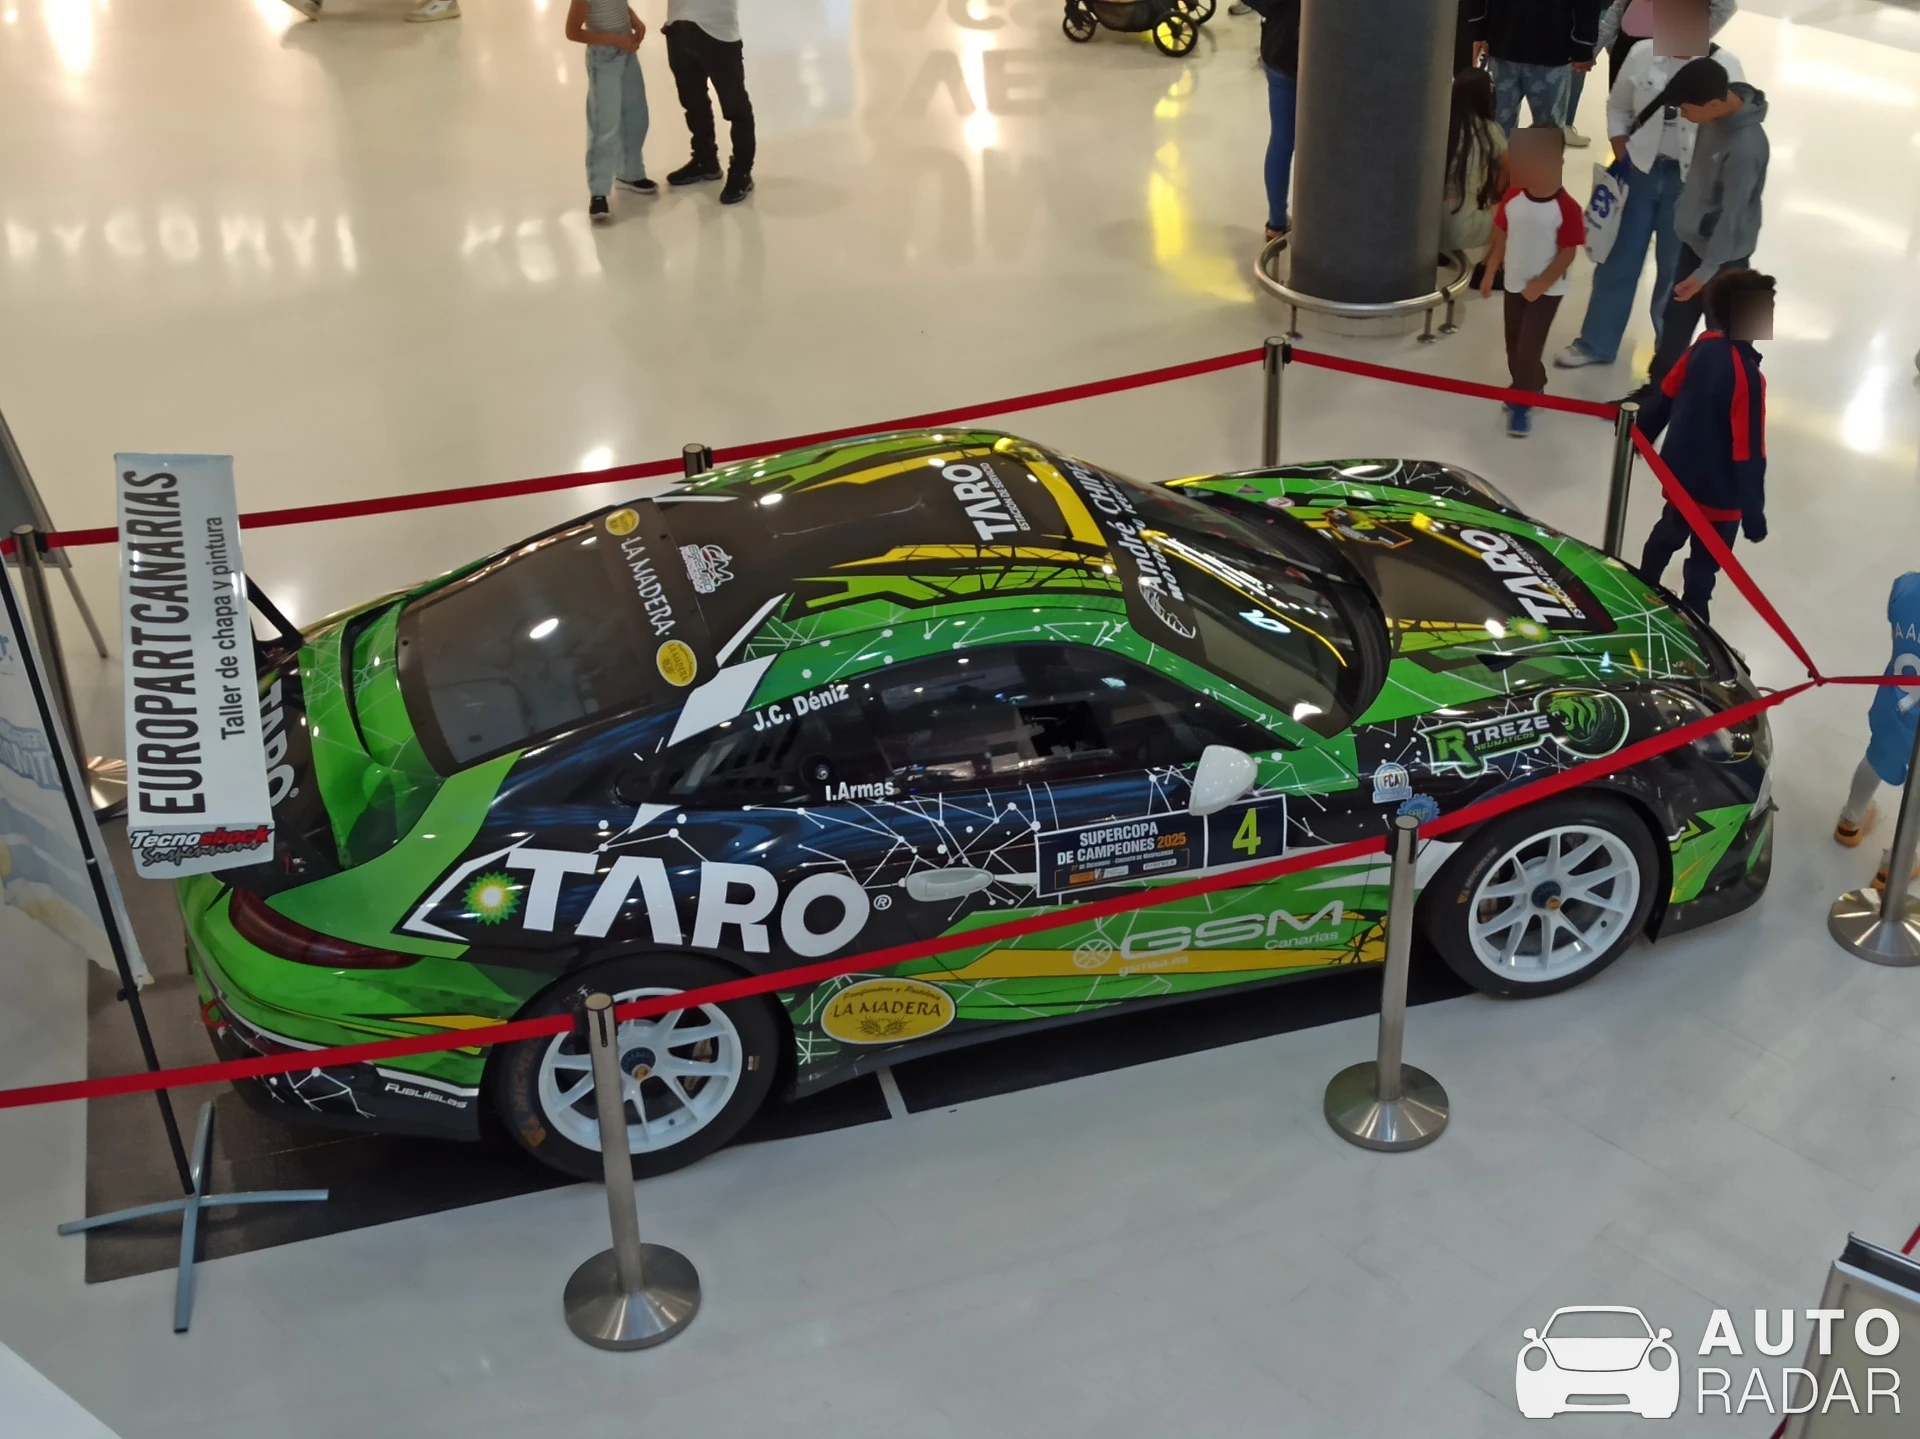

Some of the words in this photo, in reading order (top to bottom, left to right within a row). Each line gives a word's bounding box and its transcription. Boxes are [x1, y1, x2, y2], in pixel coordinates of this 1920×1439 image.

[942, 463, 1018, 541] TARO
[206, 516, 235, 577] pintura
[620, 536, 643, 559] LA
[1107, 520, 1168, 598] André
[213, 578, 235, 591] y
[629, 557, 677, 637] MADERA
[1460, 529, 1562, 623] TARO
[212, 595, 238, 651] chapa
[215, 656, 240, 679] de
[219, 685, 245, 740] Taller
[752, 702, 792, 733] J.C.
[793, 683, 850, 717] Déniz
[1467, 715, 1551, 745] TREZE
[1383, 774, 1400, 788] FCA
[130, 825, 276, 849] Tecnoshock
[142, 840, 264, 867] Suspensions
[1057, 852, 1075, 866] DE
[1077, 838, 1155, 863] CAMPEONES
[1157, 832, 1187, 849] 2025
[1079, 821, 1159, 847] SUPERCOPA
[1231, 807, 1262, 856] 4
[505, 847, 870, 957] TARO
[1119, 900, 1345, 960] GSM
[833, 1003, 853, 1018] LA
[859, 1000, 941, 1017] MADERA
